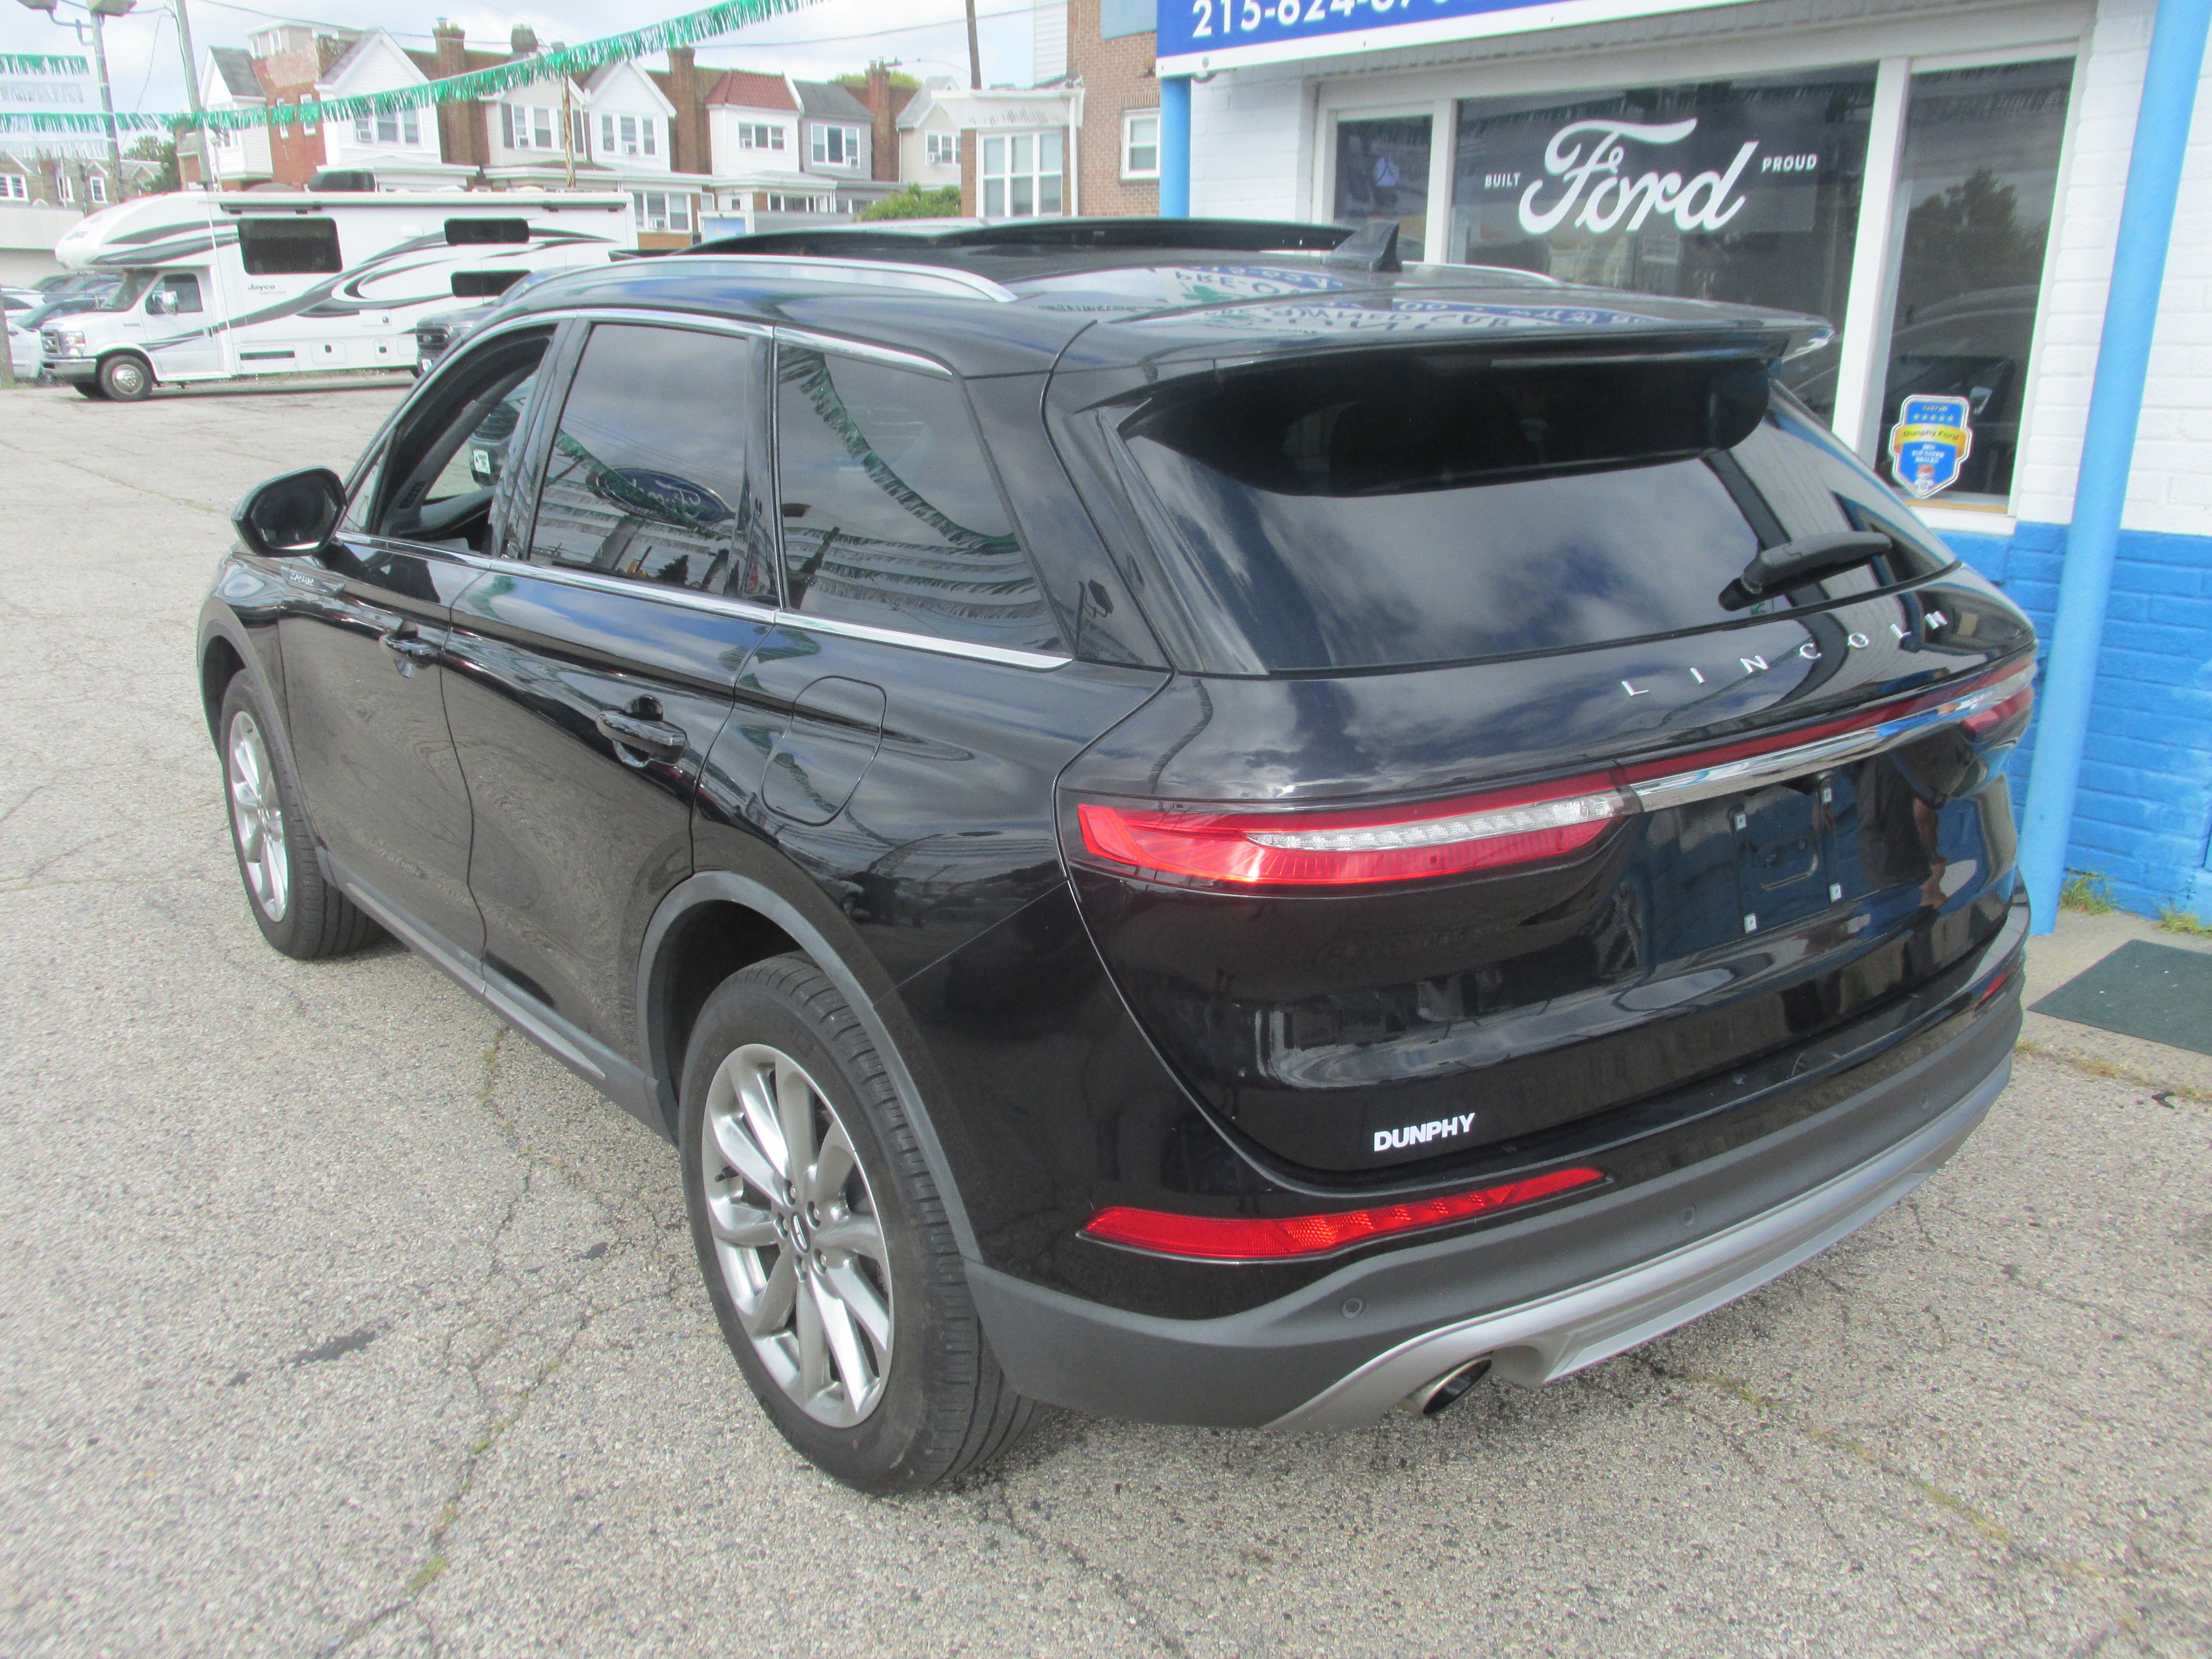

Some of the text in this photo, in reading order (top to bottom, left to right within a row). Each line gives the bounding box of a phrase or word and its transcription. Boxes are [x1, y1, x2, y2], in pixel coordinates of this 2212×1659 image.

[1484, 117, 1818, 235] BUILT Ford PROUD
[1938, 430, 1960, 440] Ford
[1620, 609, 1948, 697] LINCOLN
[1373, 1112, 1476, 1152] DUNPHY
